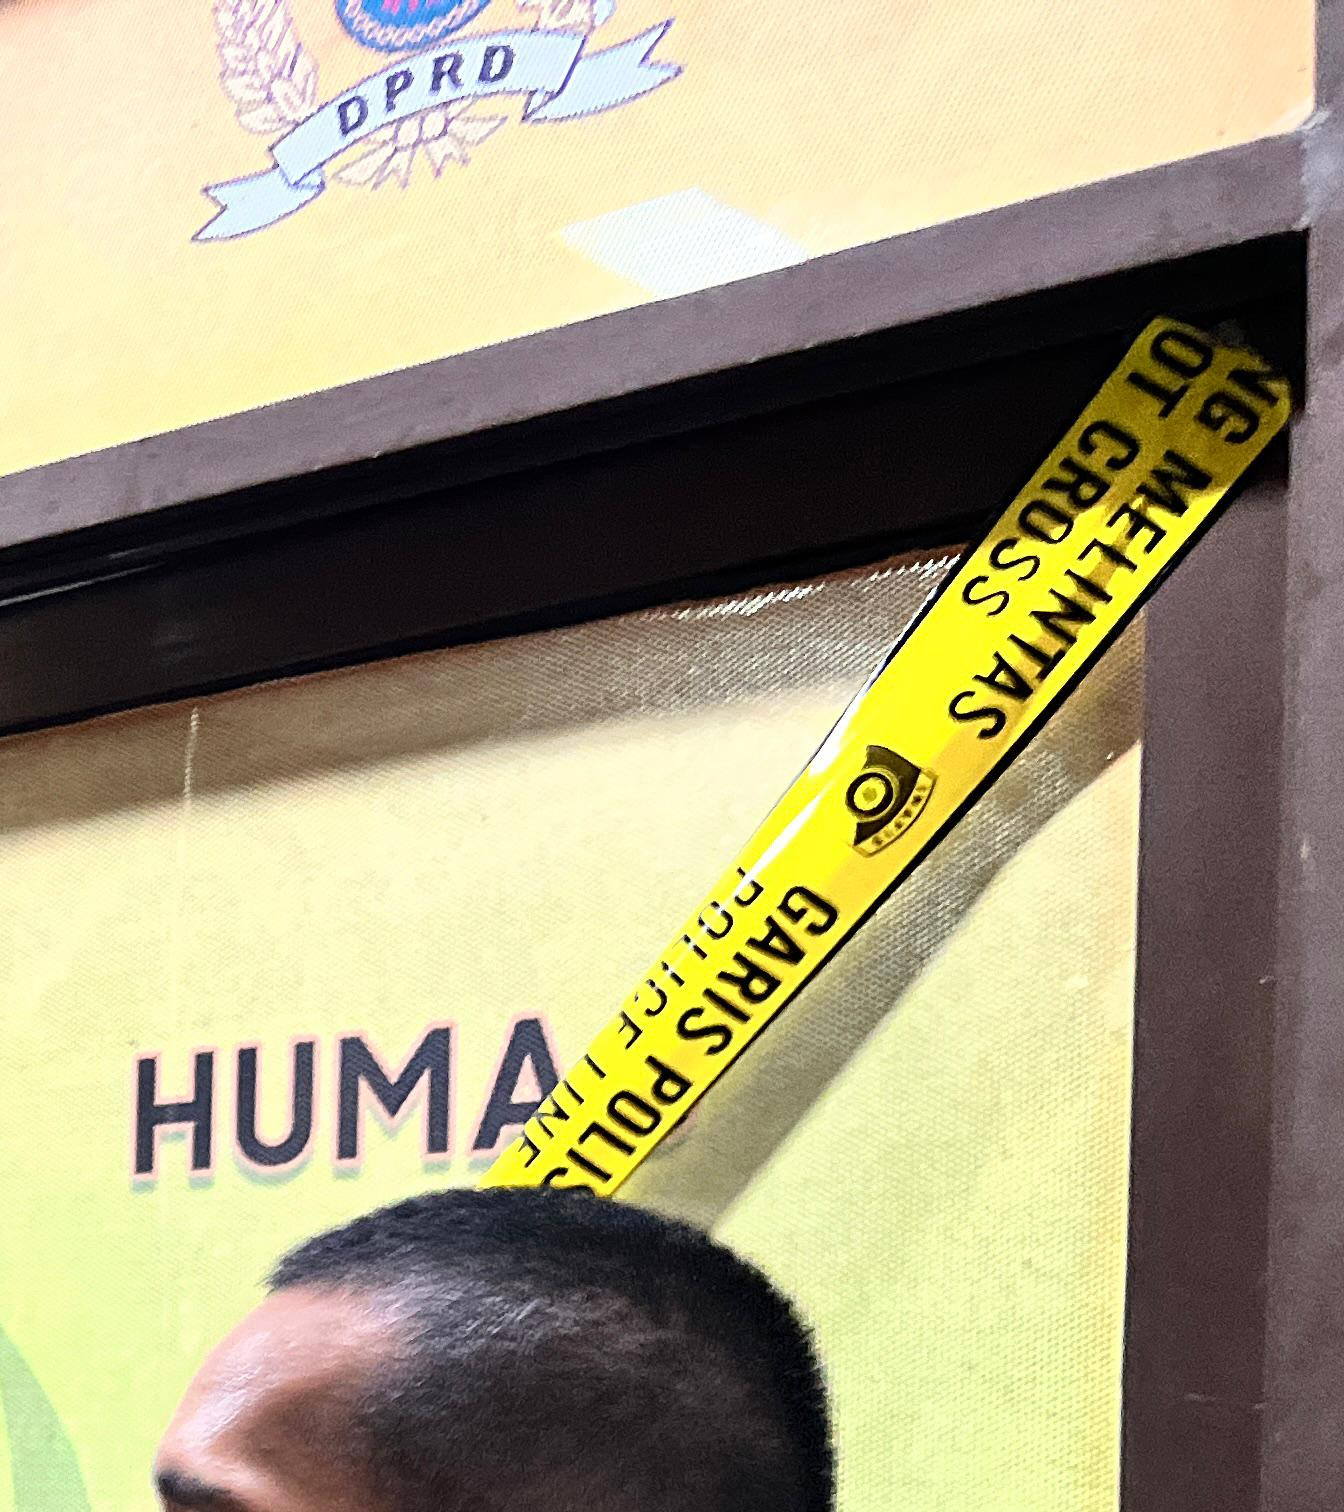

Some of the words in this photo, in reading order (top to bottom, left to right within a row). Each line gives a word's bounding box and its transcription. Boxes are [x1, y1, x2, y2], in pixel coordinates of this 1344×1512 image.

[337, 44, 516, 138] DPRD
[948, 449, 1213, 739] MELINTAS
[962, 419, 1141, 617] CROSS
[675, 884, 841, 1057] GARIS
[134, 1017, 559, 1174] HUMA
[541, 1054, 695, 1190] POLI
